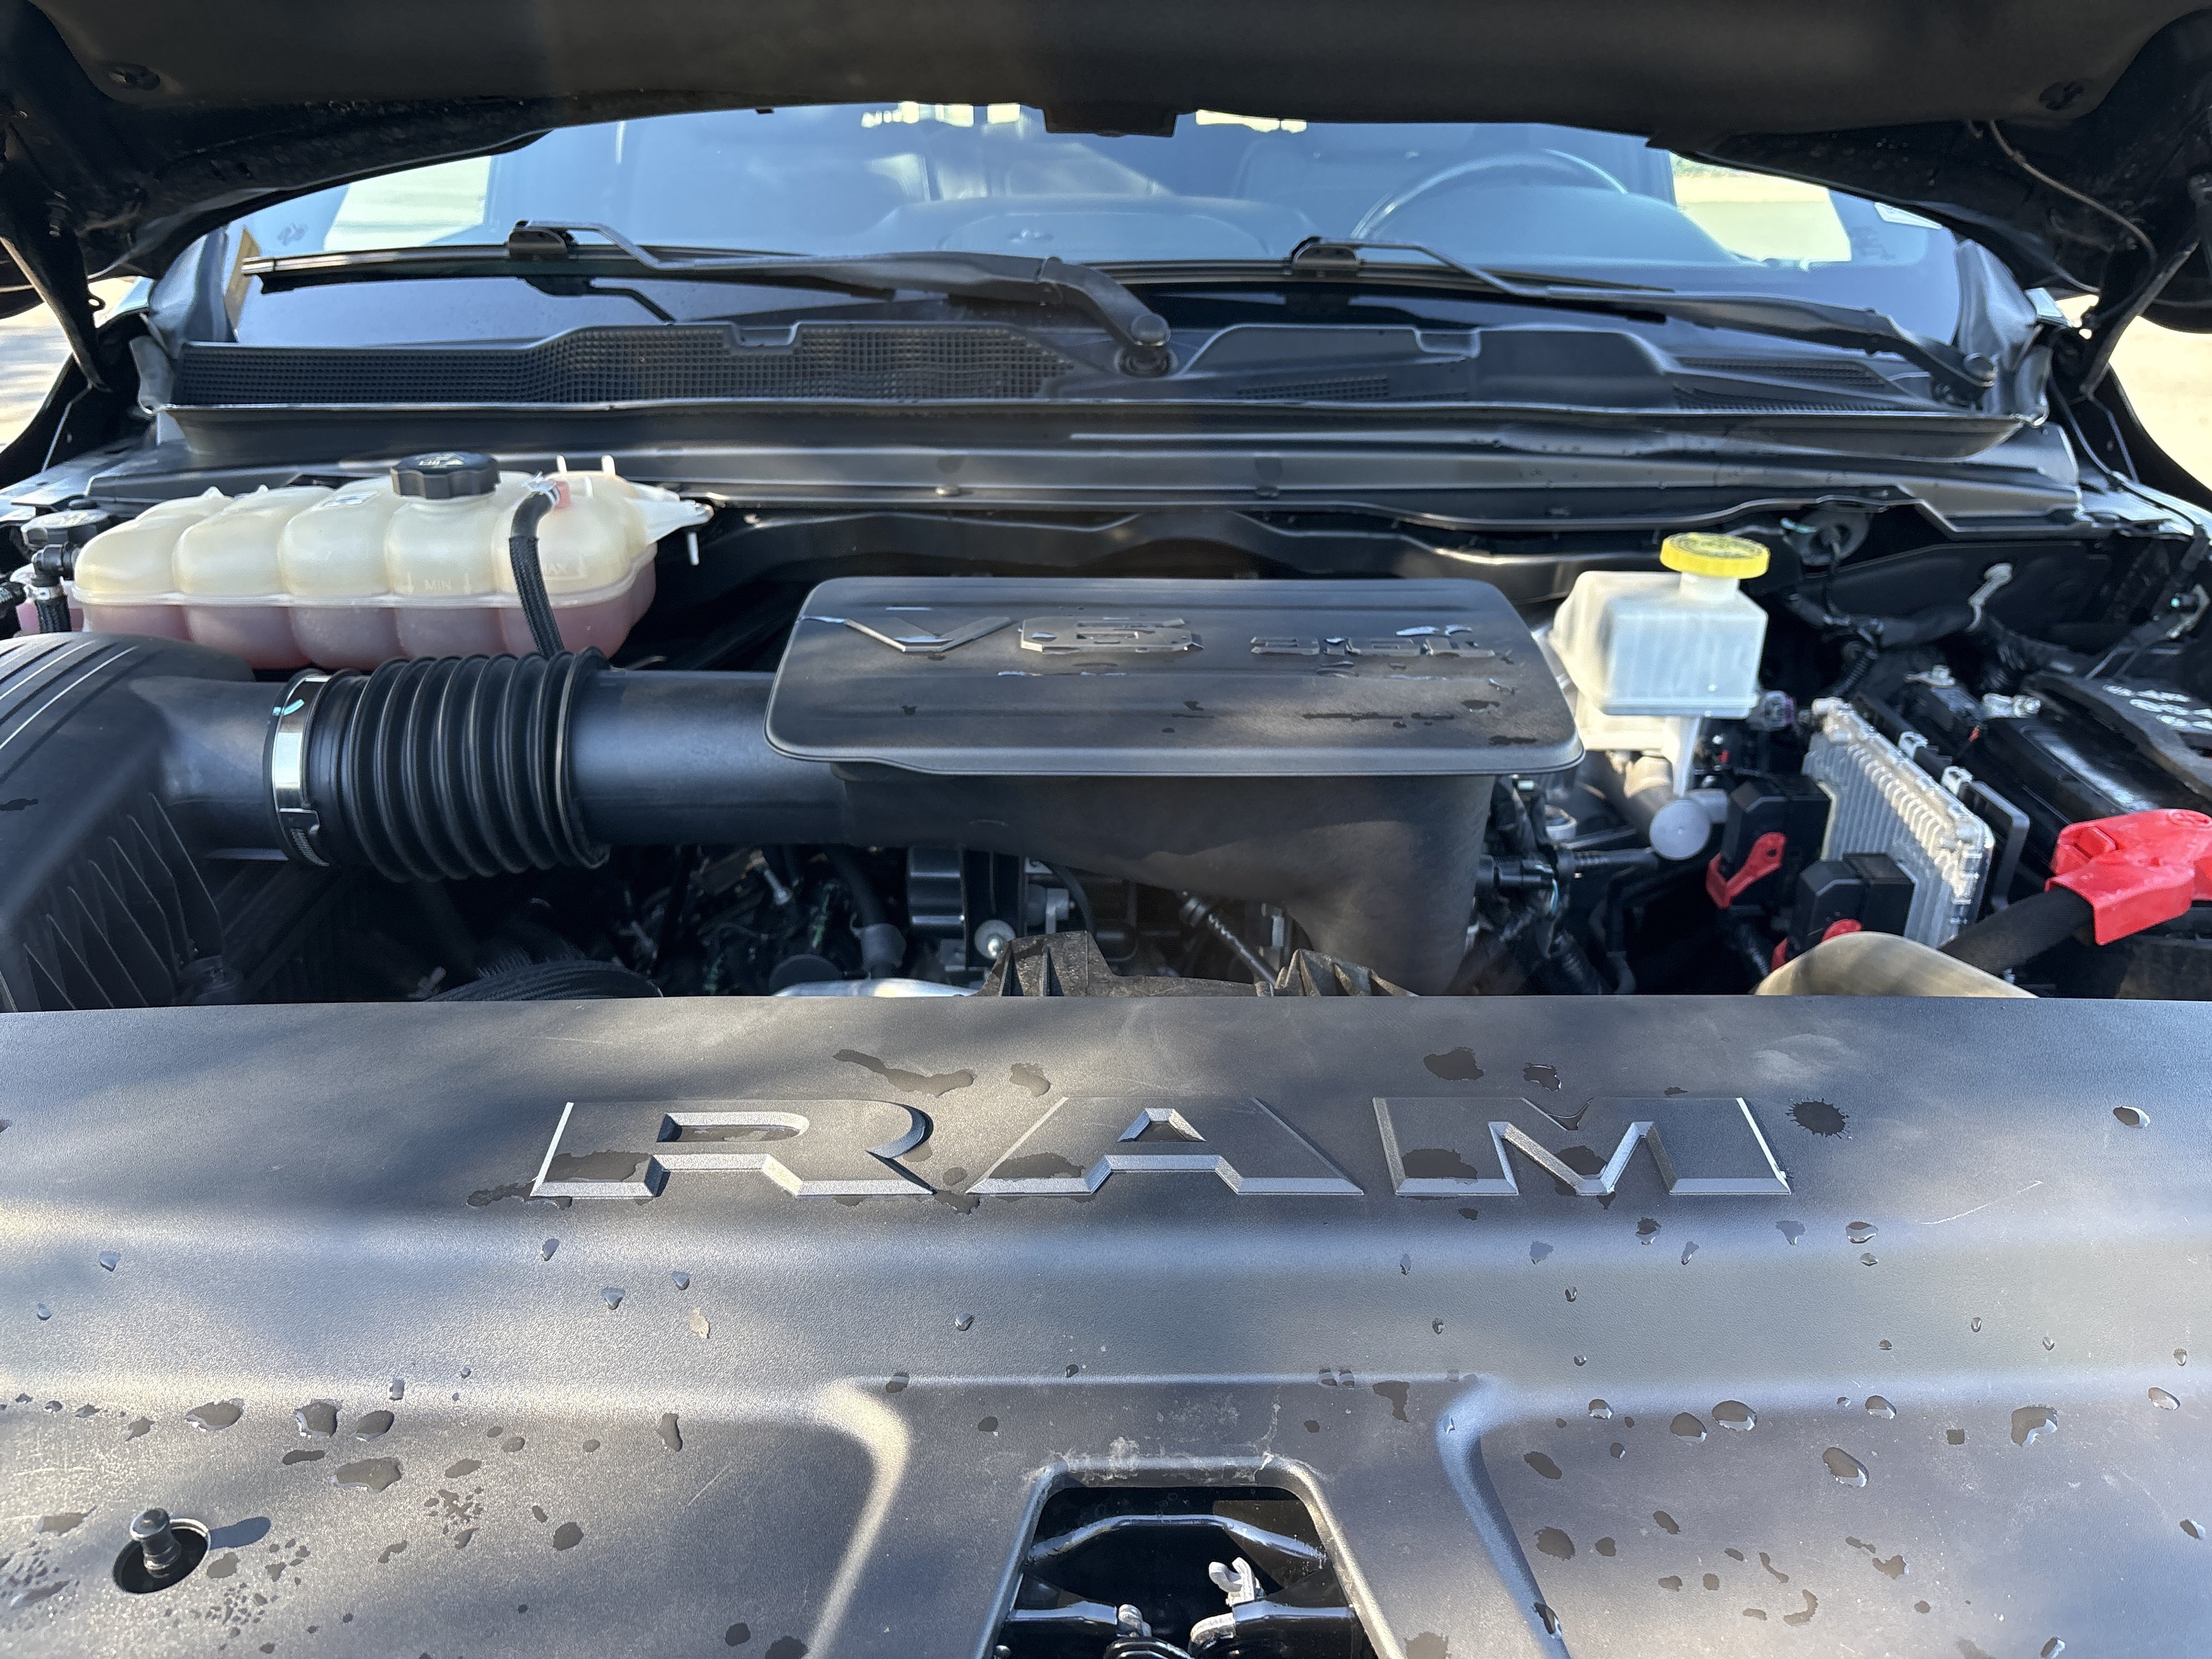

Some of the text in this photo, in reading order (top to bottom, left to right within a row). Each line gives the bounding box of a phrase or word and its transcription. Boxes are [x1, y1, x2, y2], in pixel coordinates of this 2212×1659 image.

[425, 579, 452, 591] MIN
[844, 616, 1195, 653] V6
[531, 1097, 1791, 1199] RAM
